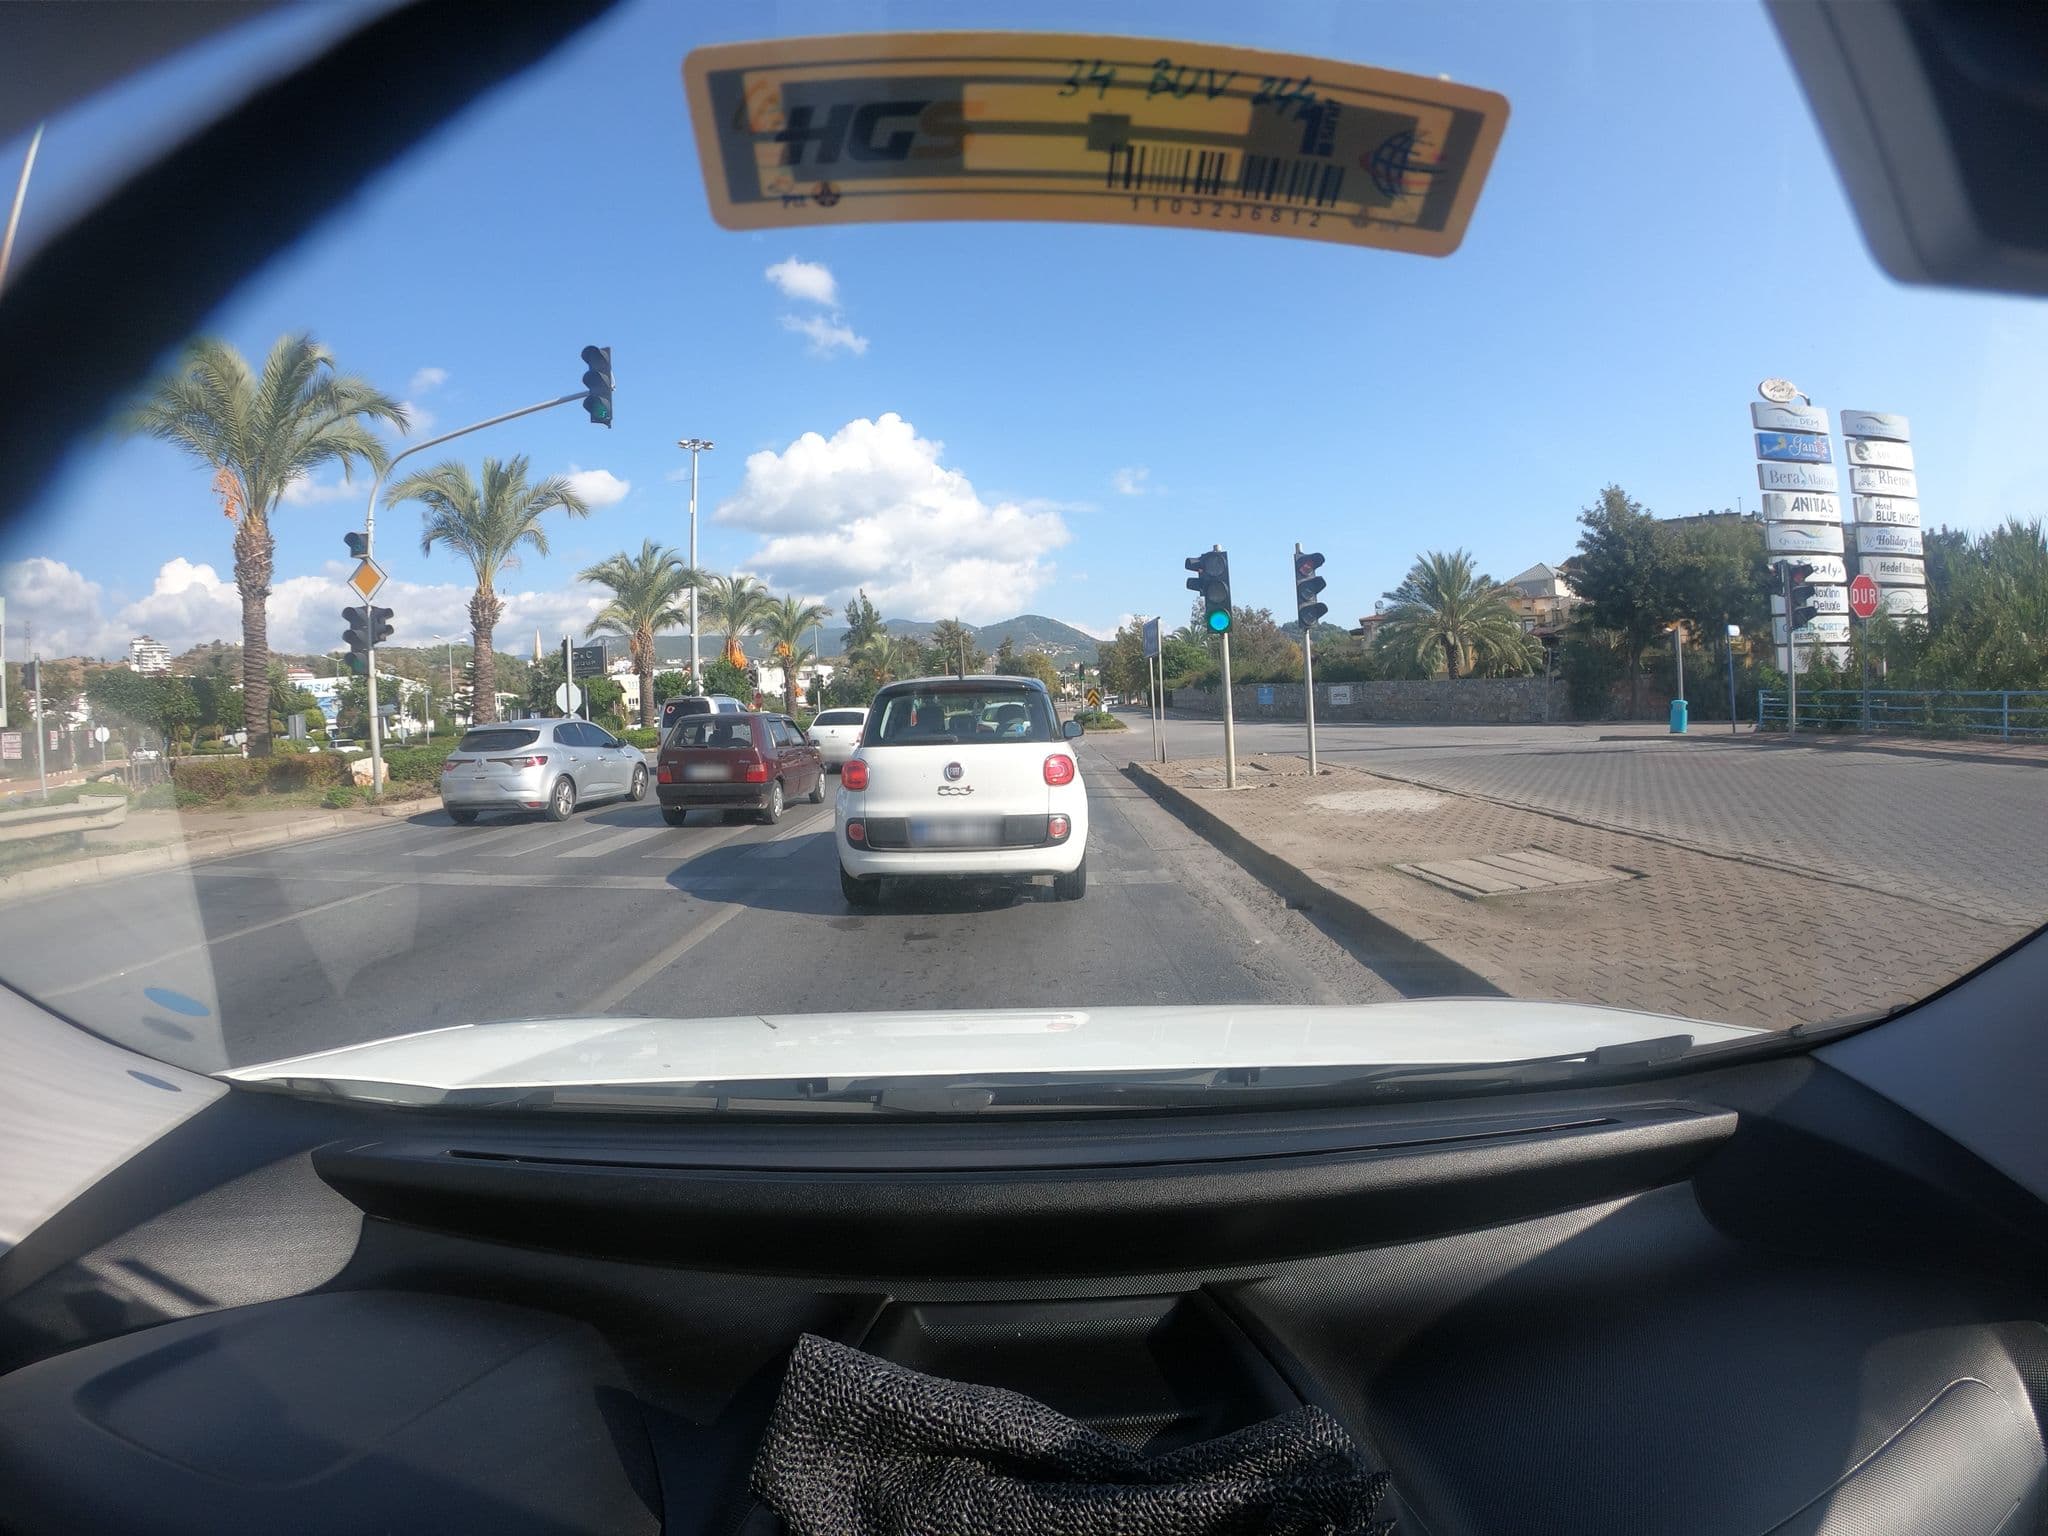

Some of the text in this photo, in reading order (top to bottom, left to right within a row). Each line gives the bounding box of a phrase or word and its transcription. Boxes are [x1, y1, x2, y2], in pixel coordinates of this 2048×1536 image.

[776, 99, 984, 165] HGS
[1769, 470, 1800, 484] Bera
[1790, 496, 1834, 513] ANITAS
[1876, 510, 1897, 523] BLUE
[1876, 533, 1908, 550] Holiday
[1880, 561, 1902, 573] Hedef
[1852, 588, 1876, 604] DUR
